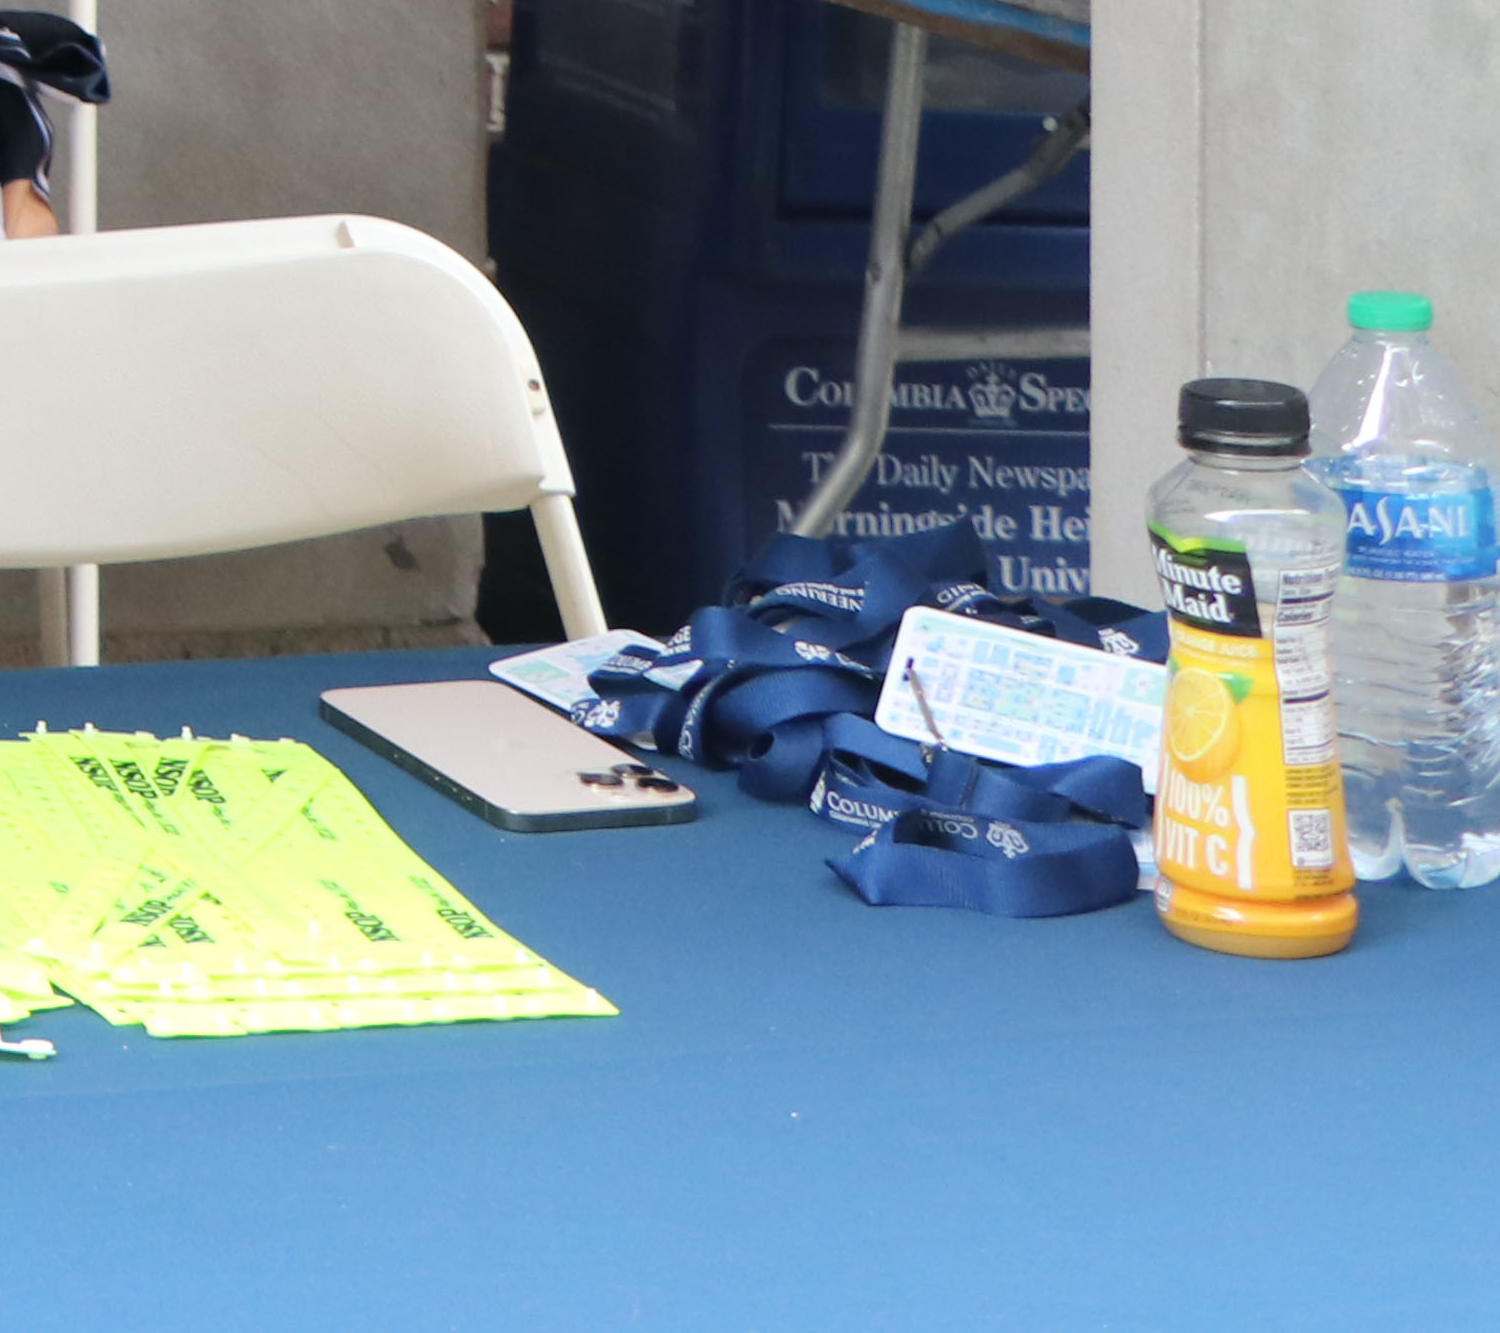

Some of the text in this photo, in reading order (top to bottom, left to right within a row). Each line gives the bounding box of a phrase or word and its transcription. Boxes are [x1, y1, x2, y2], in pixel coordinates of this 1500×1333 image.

[784, 365, 968, 411] COLMBIA
[875, 450, 959, 494] Daily
[1347, 495, 1470, 547] ASANI
[1151, 543, 1243, 596] Minute
[1162, 579, 1236, 624] Maid
[104, 747, 162, 809] NSOP
[1167, 768, 1230, 828] 100%
[1165, 814, 1230, 877] VIT C
